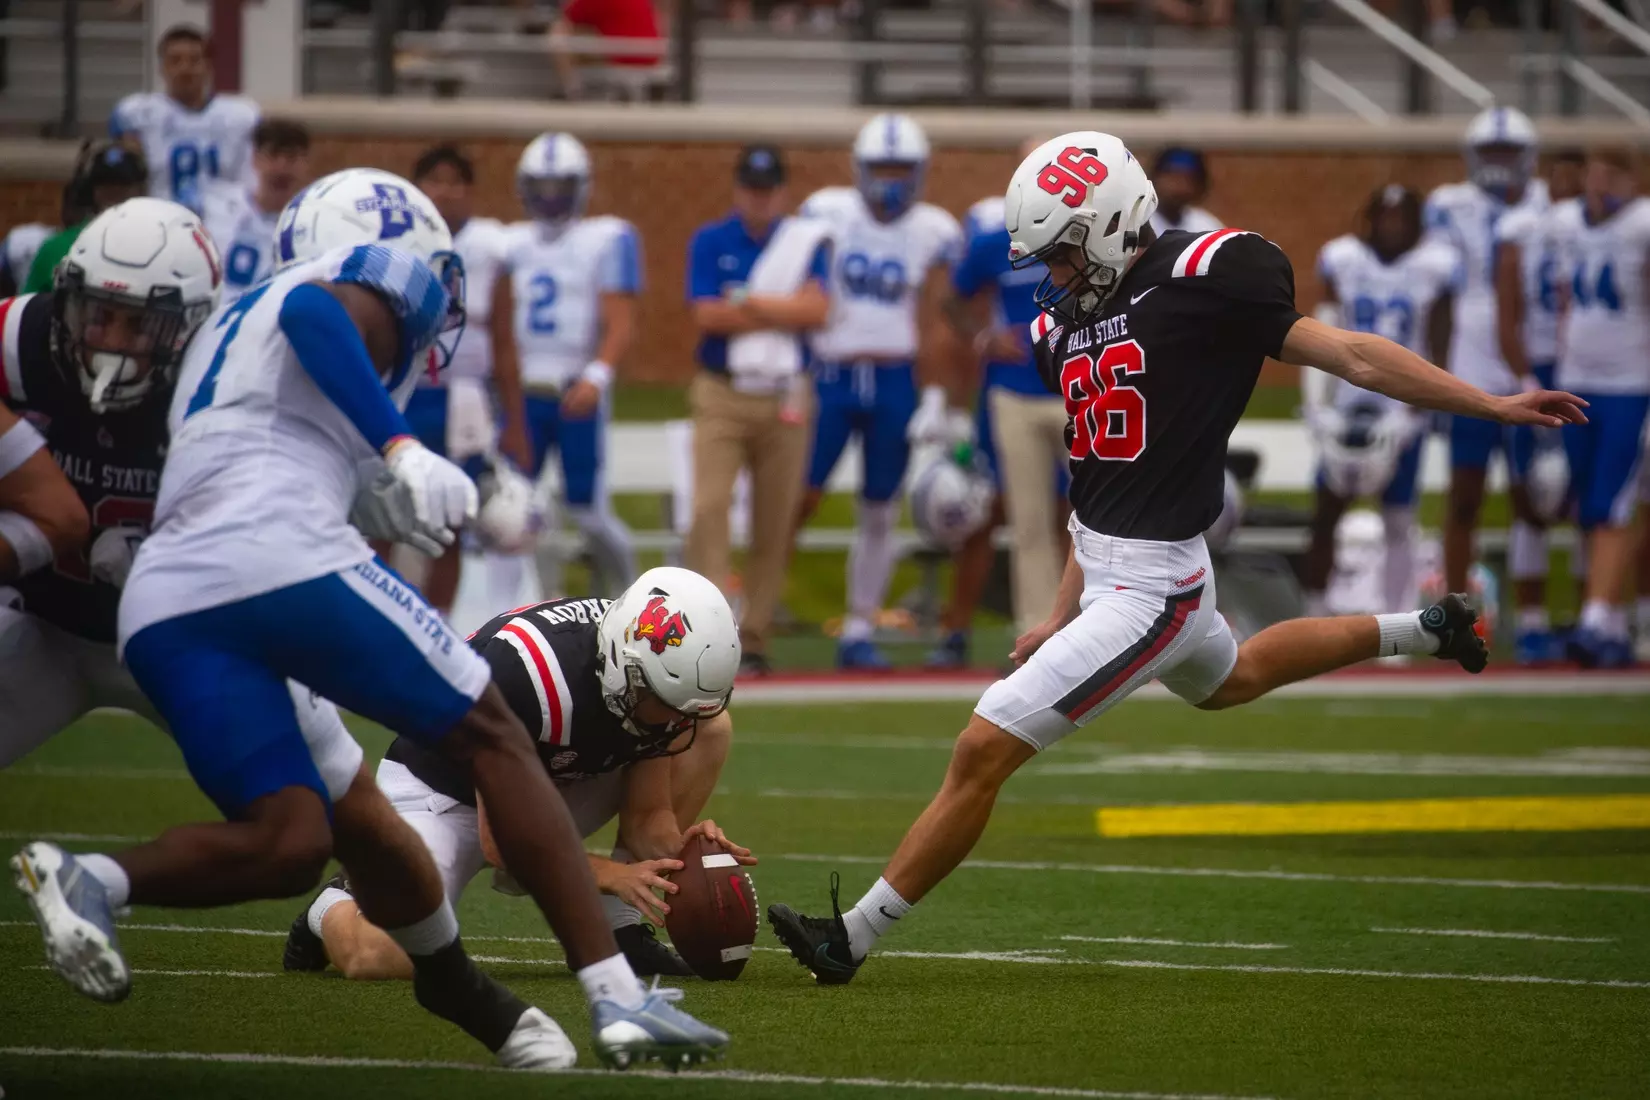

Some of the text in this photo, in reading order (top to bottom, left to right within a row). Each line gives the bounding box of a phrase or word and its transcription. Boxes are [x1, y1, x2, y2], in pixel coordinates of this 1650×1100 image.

[1037, 146, 1108, 208] 96
[528, 273, 557, 335] 2
[1095, 313, 1128, 344] STATE
[183, 282, 275, 421] 7
[1060, 338, 1146, 461] 96
